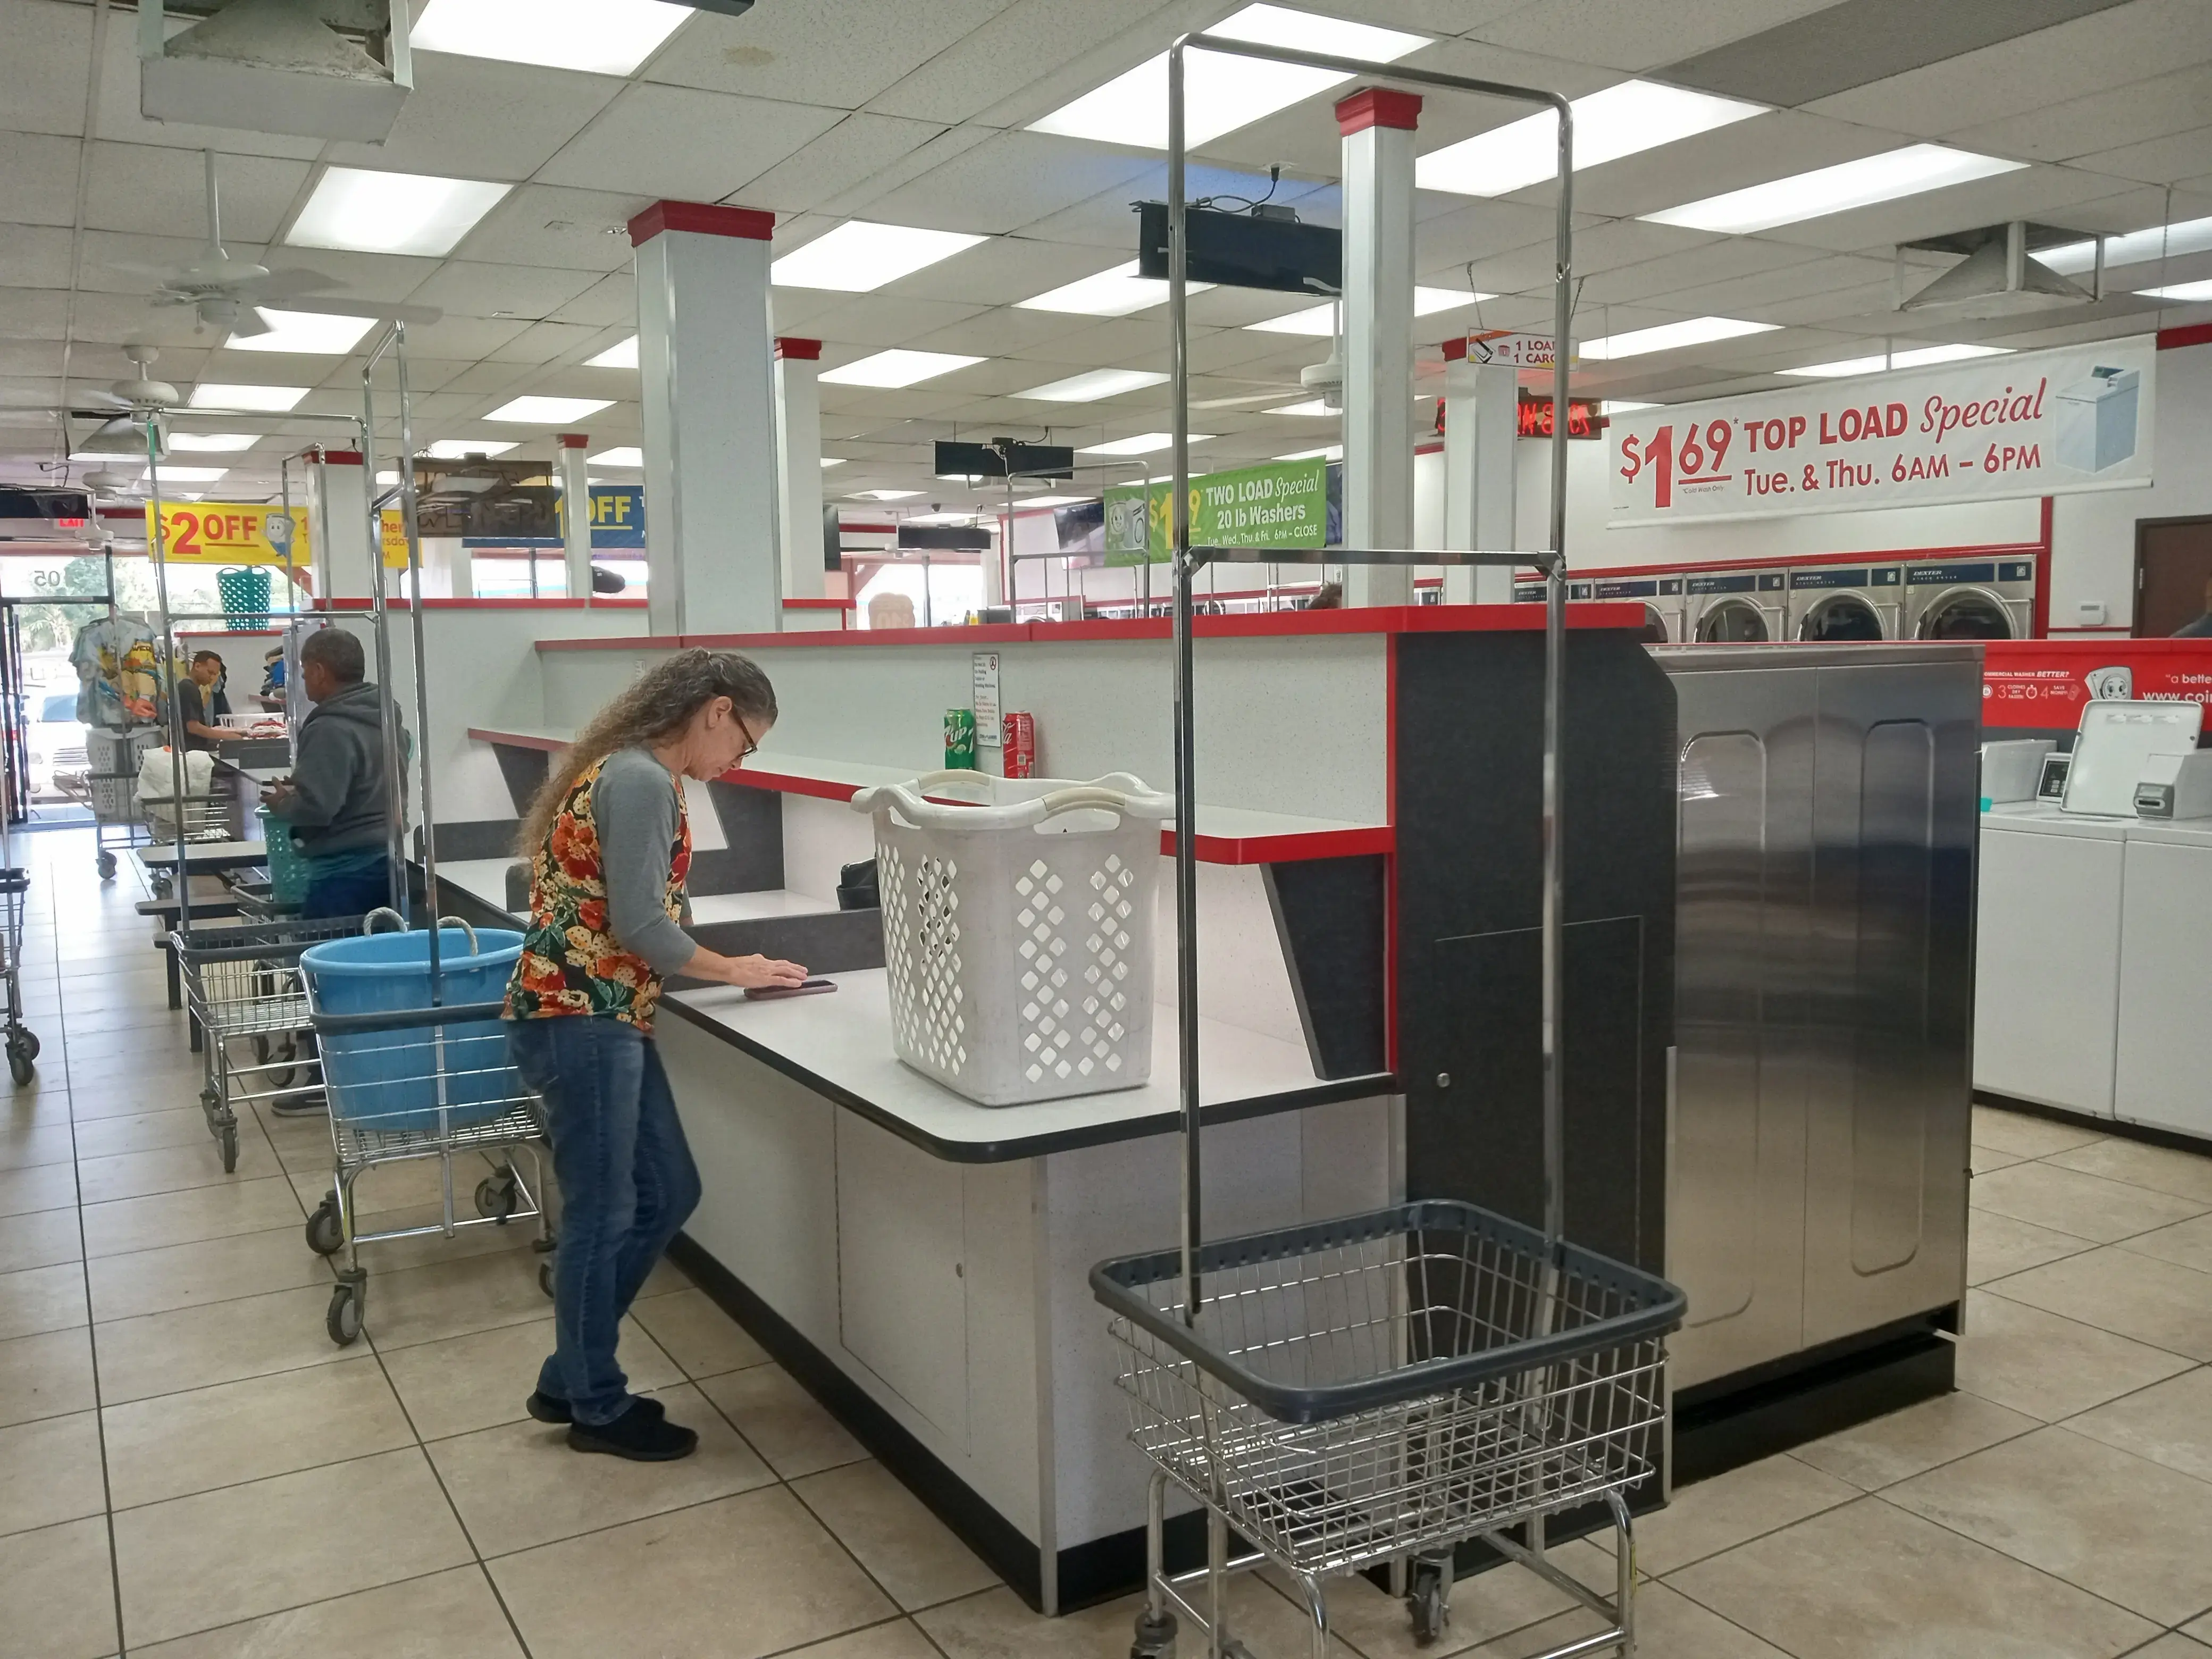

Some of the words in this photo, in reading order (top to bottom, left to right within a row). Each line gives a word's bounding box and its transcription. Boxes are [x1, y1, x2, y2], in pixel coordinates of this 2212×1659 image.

[1516, 341, 1521, 351] 1
[1528, 341, 1555, 351] LOA
[1513, 353, 1519, 363] 1
[1744, 416, 1806, 453] TOP
[1819, 403, 1908, 445] LOAD
[1920, 377, 2047, 443] Special
[1744, 468, 1794, 496] Tue.
[1802, 464, 1820, 491] &
[1826, 459, 1880, 489] Thu.
[1891, 454, 1949, 482] 6AM
[1983, 442, 2041, 473] 6PM
[1206, 484, 1234, 507] TWO
[1238, 478, 1273, 501] LOAD
[1275, 470, 1320, 502] Special
[203, 514, 258, 540] OFF
[1217, 510, 1231, 530] 20
[1235, 509, 1246, 527] lb
[1250, 503, 1306, 525] Washers
[1255, 533, 1260, 541] &
[1261, 531, 1270, 541] Fri.
[1275, 529, 1287, 540] 6PM
[1294, 524, 1317, 538] CLOSE
[1998, 685, 2007, 699] 3
[2040, 685, 2049, 700] 4
